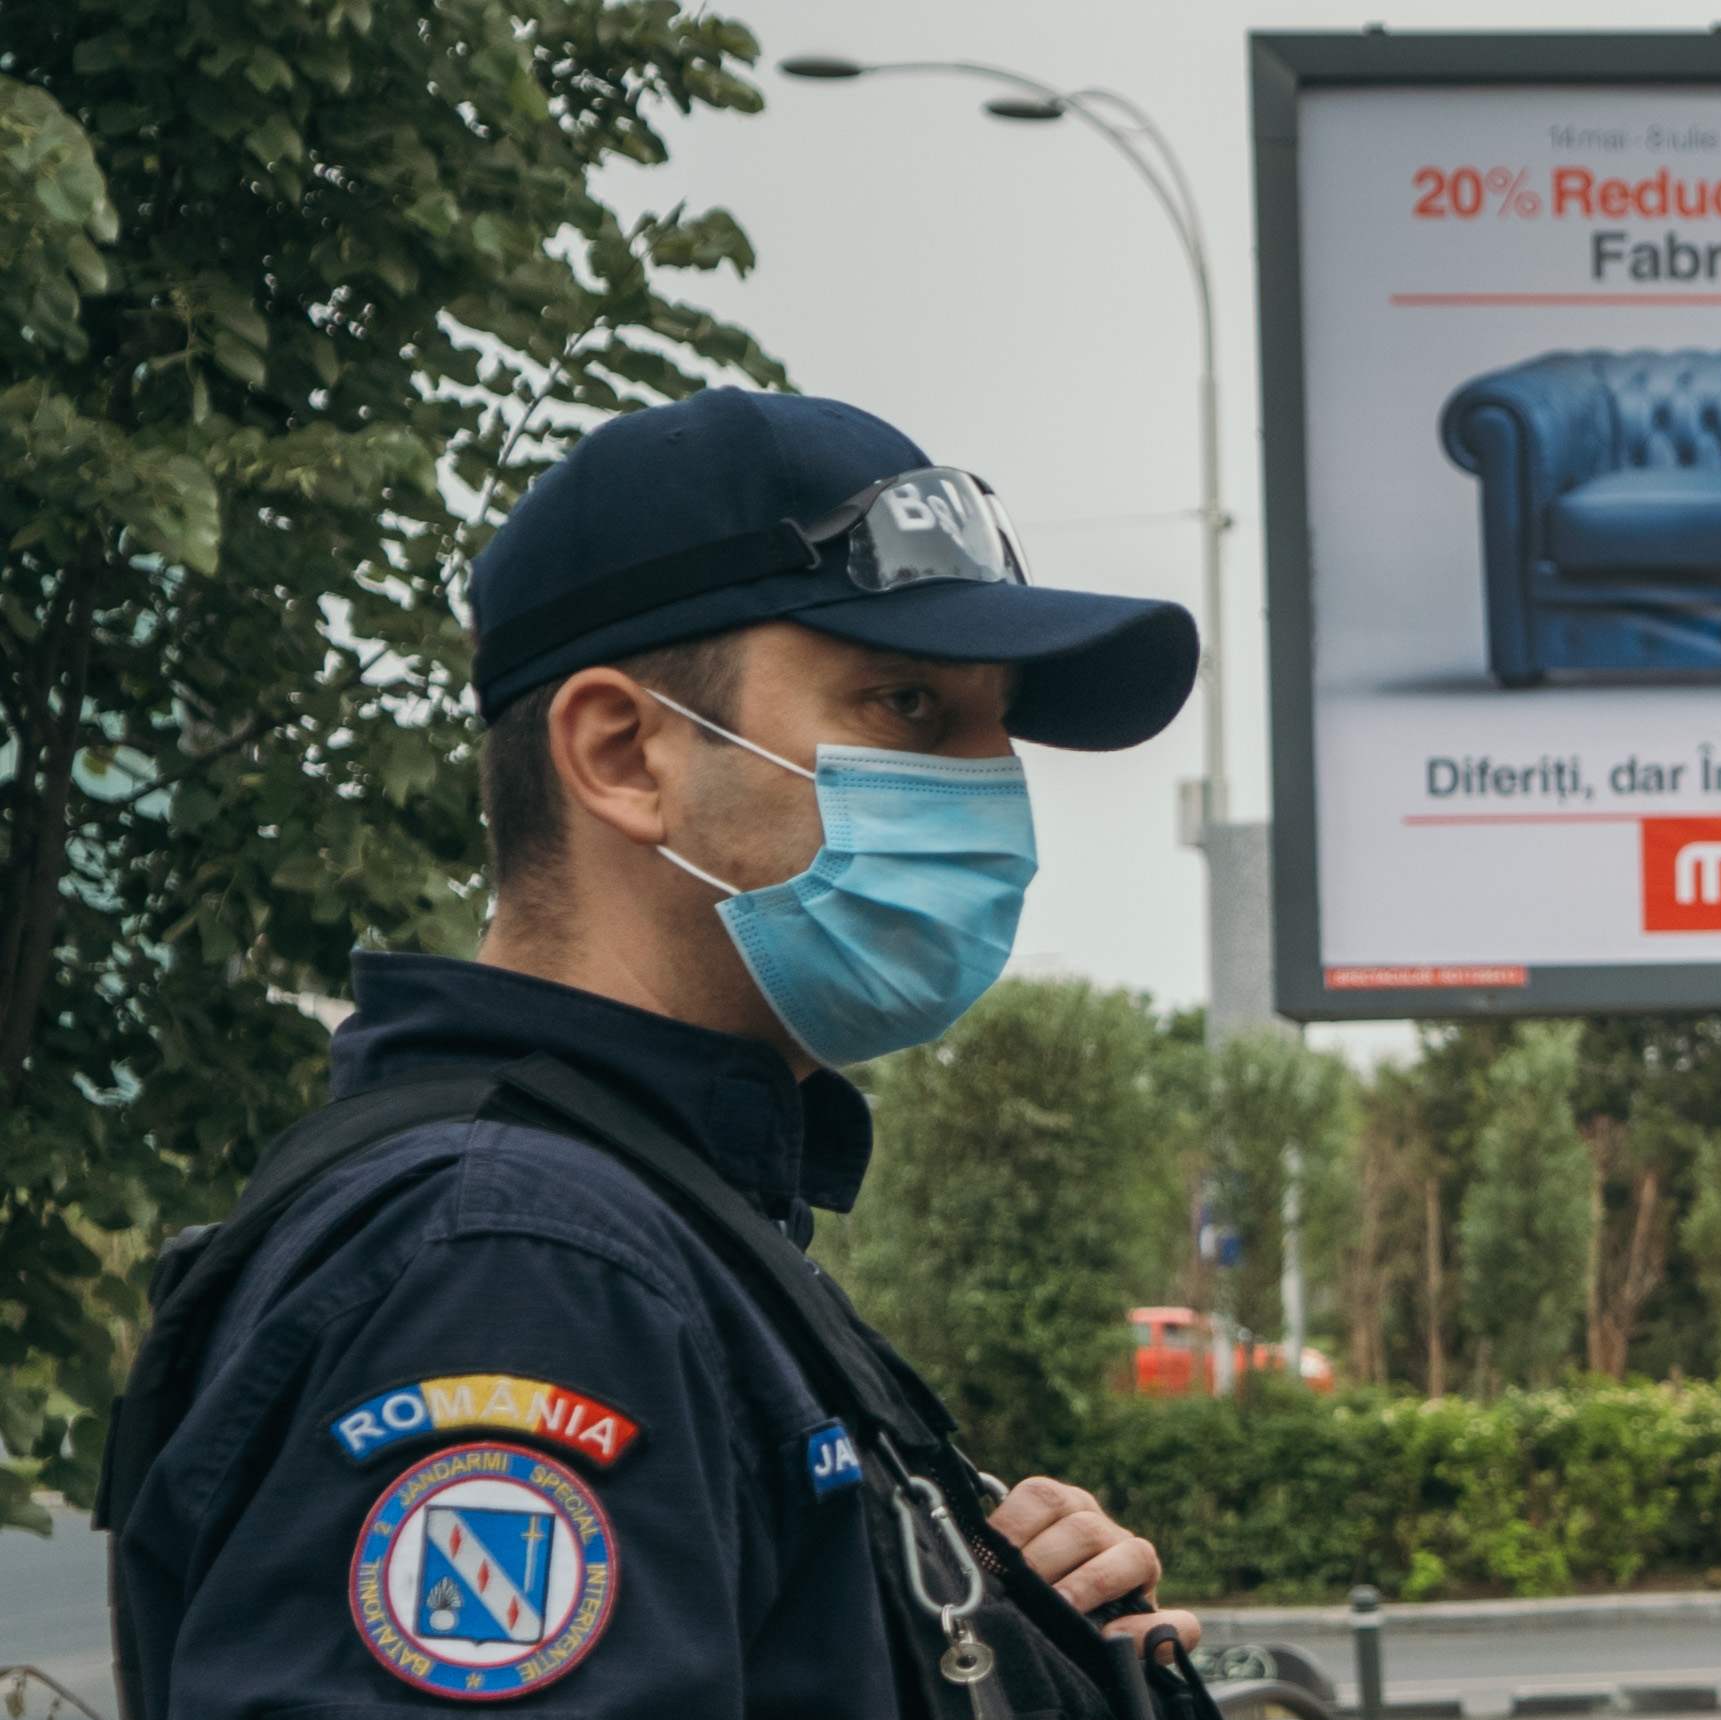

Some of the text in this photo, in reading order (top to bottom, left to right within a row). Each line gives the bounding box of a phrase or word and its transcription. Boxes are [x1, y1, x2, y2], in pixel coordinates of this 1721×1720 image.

[1412, 165, 1541, 220] 20%
[1608, 754, 1686, 796] dar
[338, 1376, 617, 1456] ROMÂNIA
[402, 1451, 510, 1507] JANDARMI
[529, 1464, 599, 1546] SPECIAL
[373, 1520, 392, 1536] 2
[358, 1556, 436, 1679] BATALIONUL
